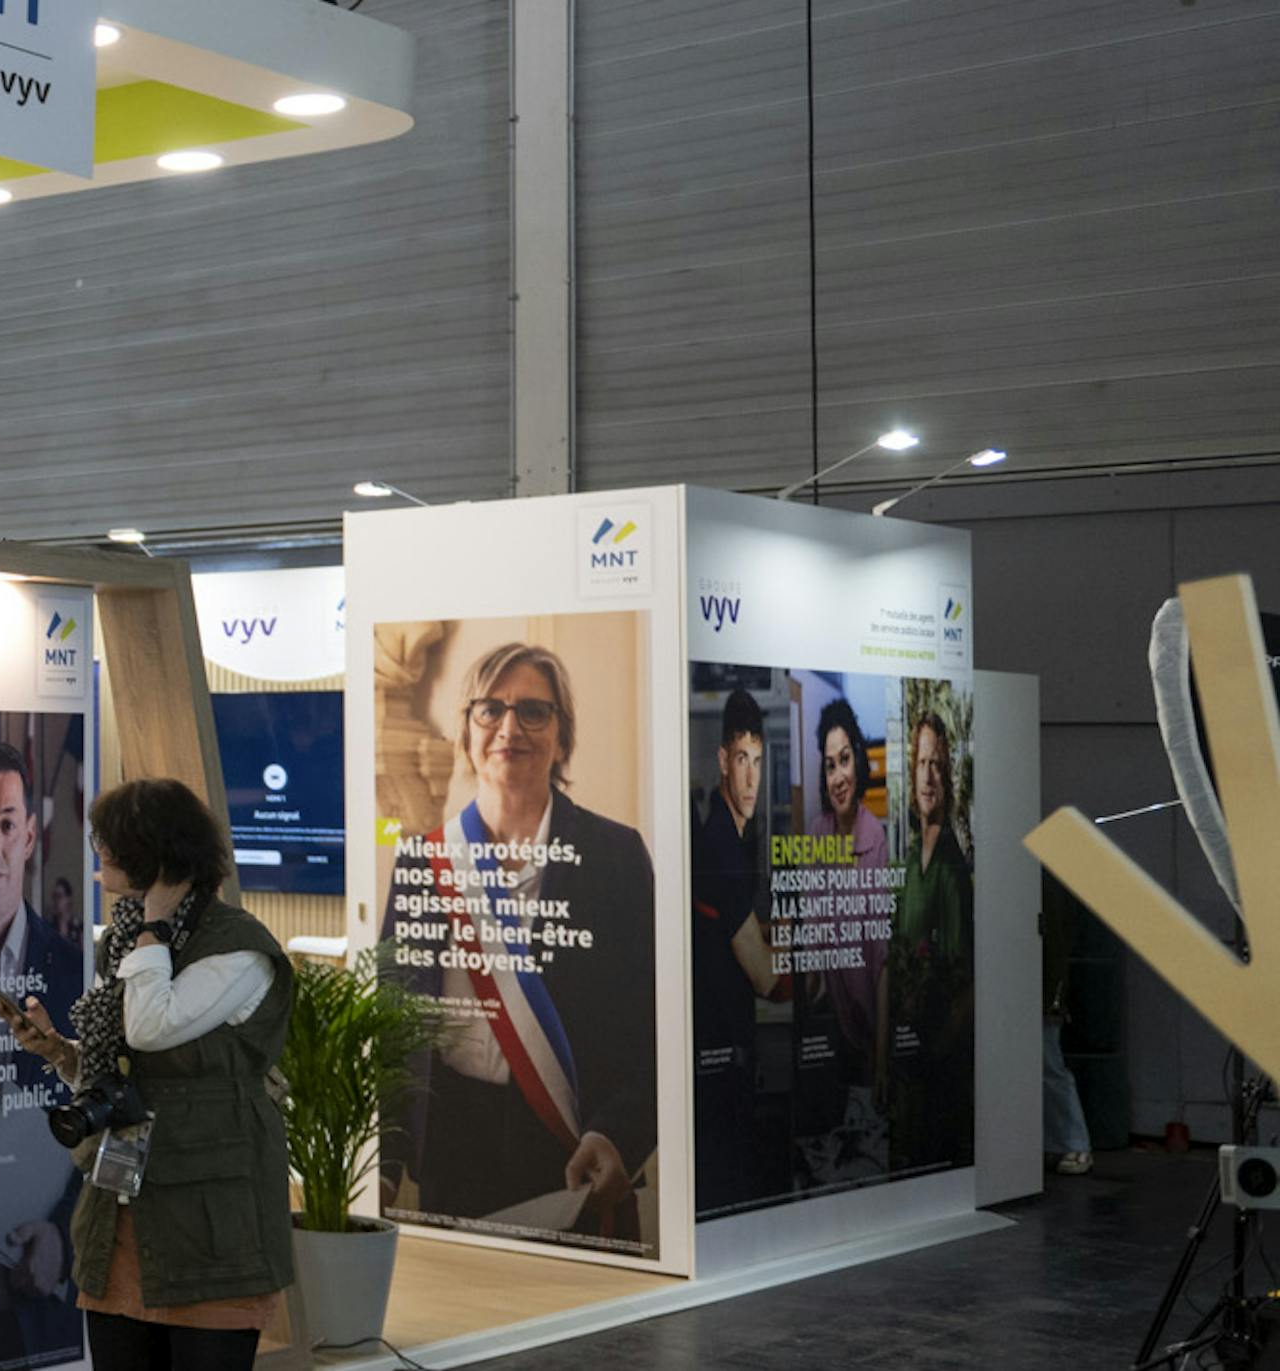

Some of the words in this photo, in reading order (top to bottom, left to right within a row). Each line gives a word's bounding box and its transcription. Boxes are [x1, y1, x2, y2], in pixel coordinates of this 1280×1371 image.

[0, 70, 51, 106] vyv
[592, 550, 638, 568] MNT
[700, 595, 741, 632] vyv
[222, 617, 277, 644] vyv
[944, 627, 963, 641] MNT
[45, 649, 76, 666] MNT
[395, 836, 462, 858] Mieux
[469, 838, 581, 867] protégés,
[771, 834, 858, 866] ENSEMBLE,
[395, 868, 434, 885] nos
[439, 868, 518, 891] agents
[771, 870, 825, 891] AGISSONS
[828, 869, 858, 889] POUR
[861, 868, 873, 887] LE
[875, 868, 906, 887] DROIT
[395, 890, 490, 917] agissent
[496, 893, 571, 919] mieux
[782, 898, 797, 918] LA
[799, 891, 834, 918] SANTÉ
[836, 895, 867, 915] POUR
[869, 894, 897, 914] TOUS
[395, 920, 448, 945] pour
[453, 919, 474, 941] le
[480, 920, 593, 948] bien-être
[772, 926, 791, 946] LES
[793, 923, 839, 945] AGENTS,
[840, 922, 863, 942] SUR
[864, 920, 892, 941] TOUS
[395, 945, 434, 966] des
[772, 953, 791, 974] LES
[794, 948, 866, 973] TERRITOIRES.
